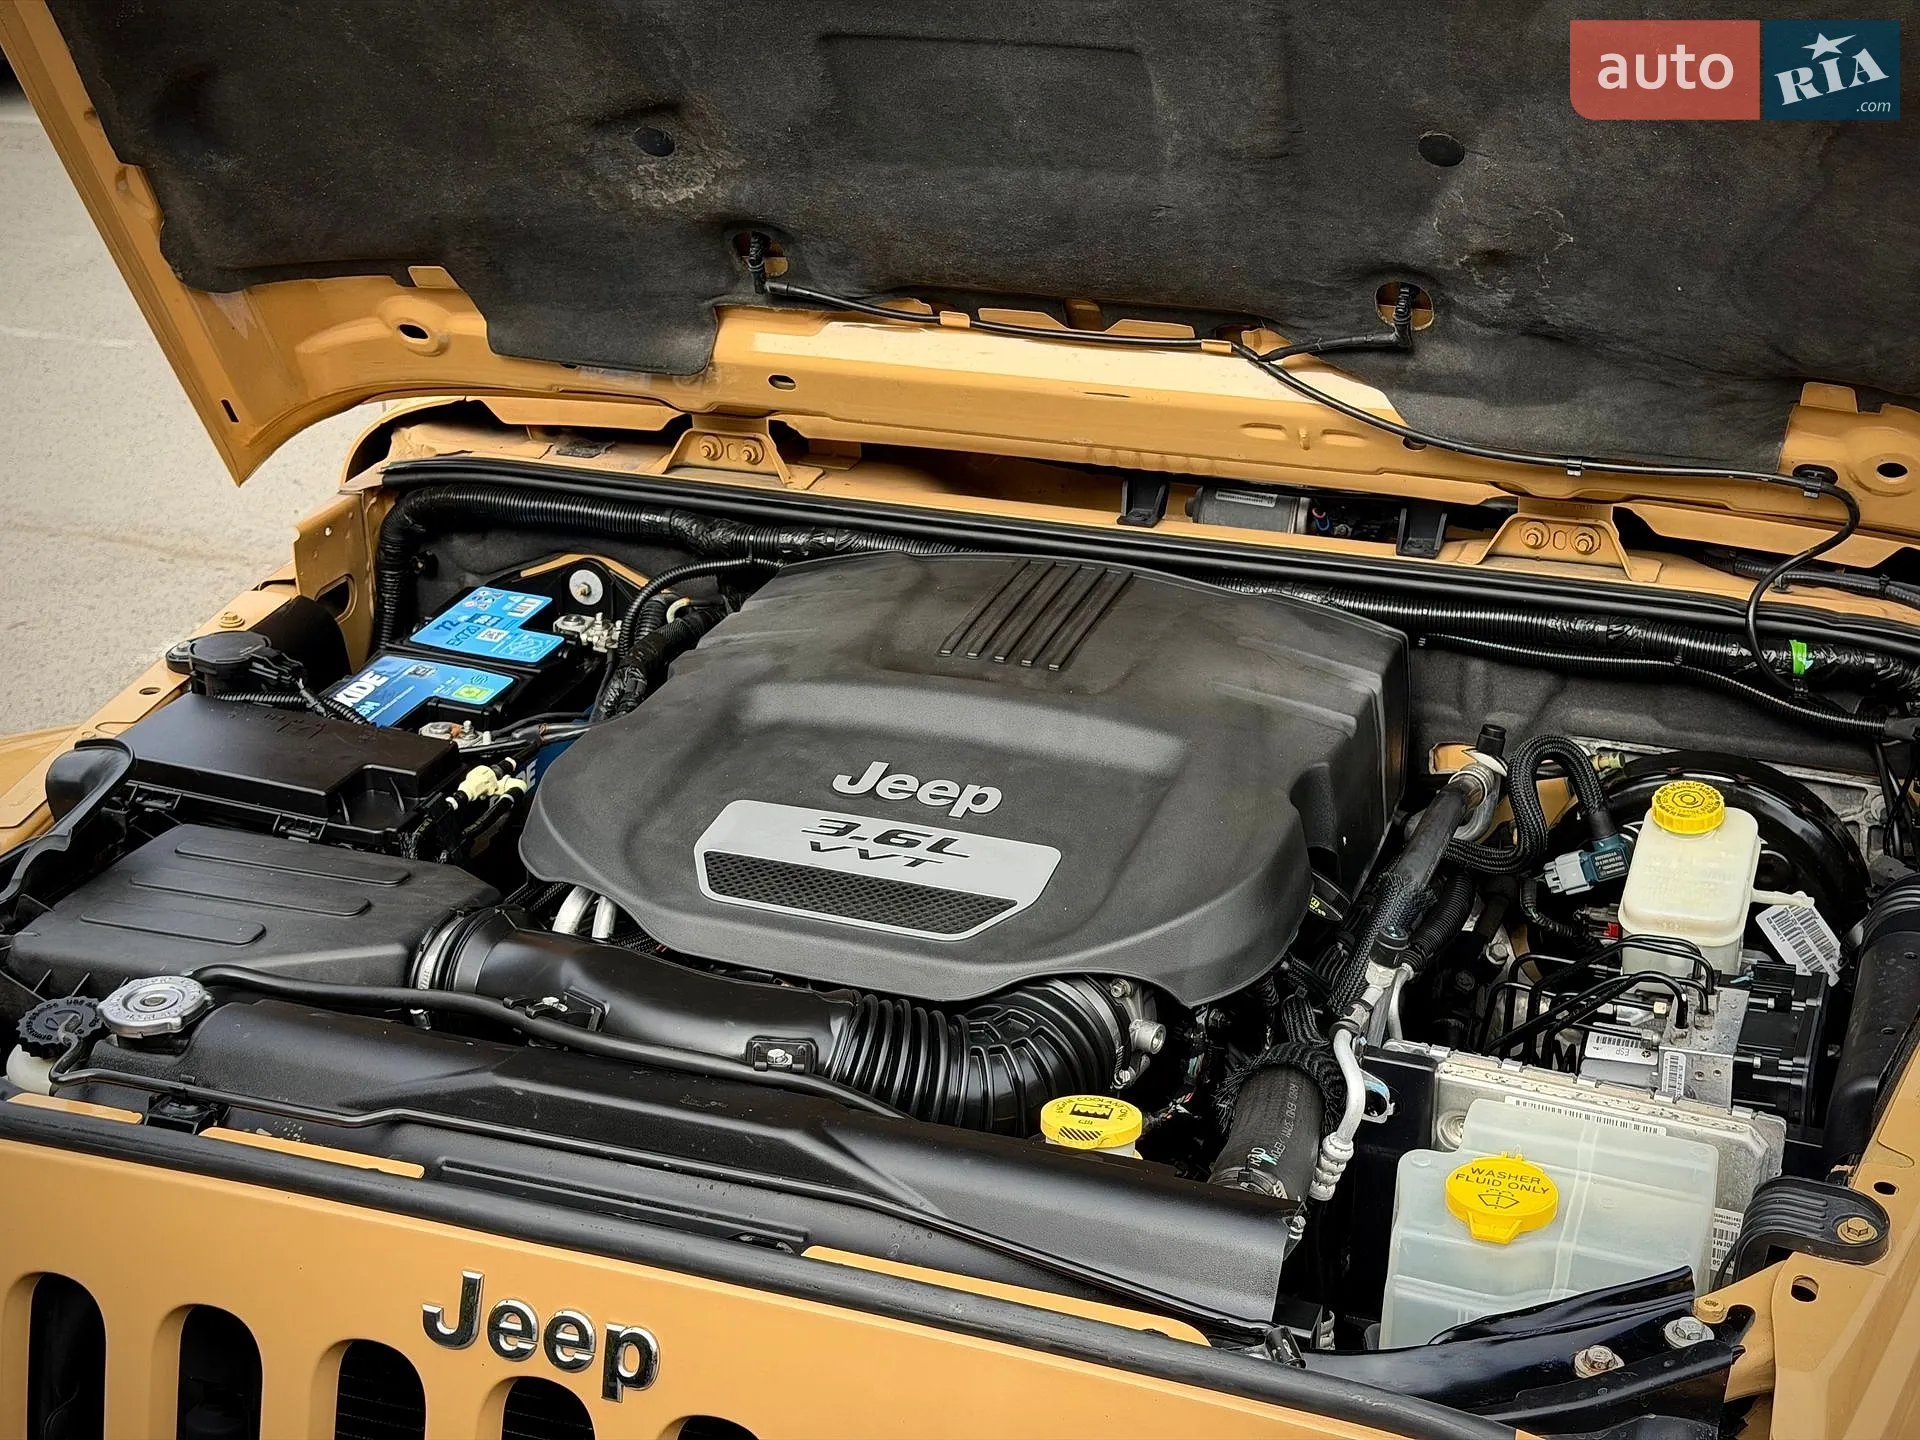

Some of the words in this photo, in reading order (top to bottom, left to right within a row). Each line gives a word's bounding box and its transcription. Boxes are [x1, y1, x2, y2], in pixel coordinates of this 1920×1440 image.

[832, 761, 1002, 819] Jeep
[801, 818, 970, 858] 3.6L
[809, 841, 944, 868] VVT
[1455, 1173, 1502, 1187] FLUID
[1508, 1182, 1550, 1195] ONLY
[1471, 1167, 1541, 1185] WASHER
[422, 1270, 661, 1403] Jeep
